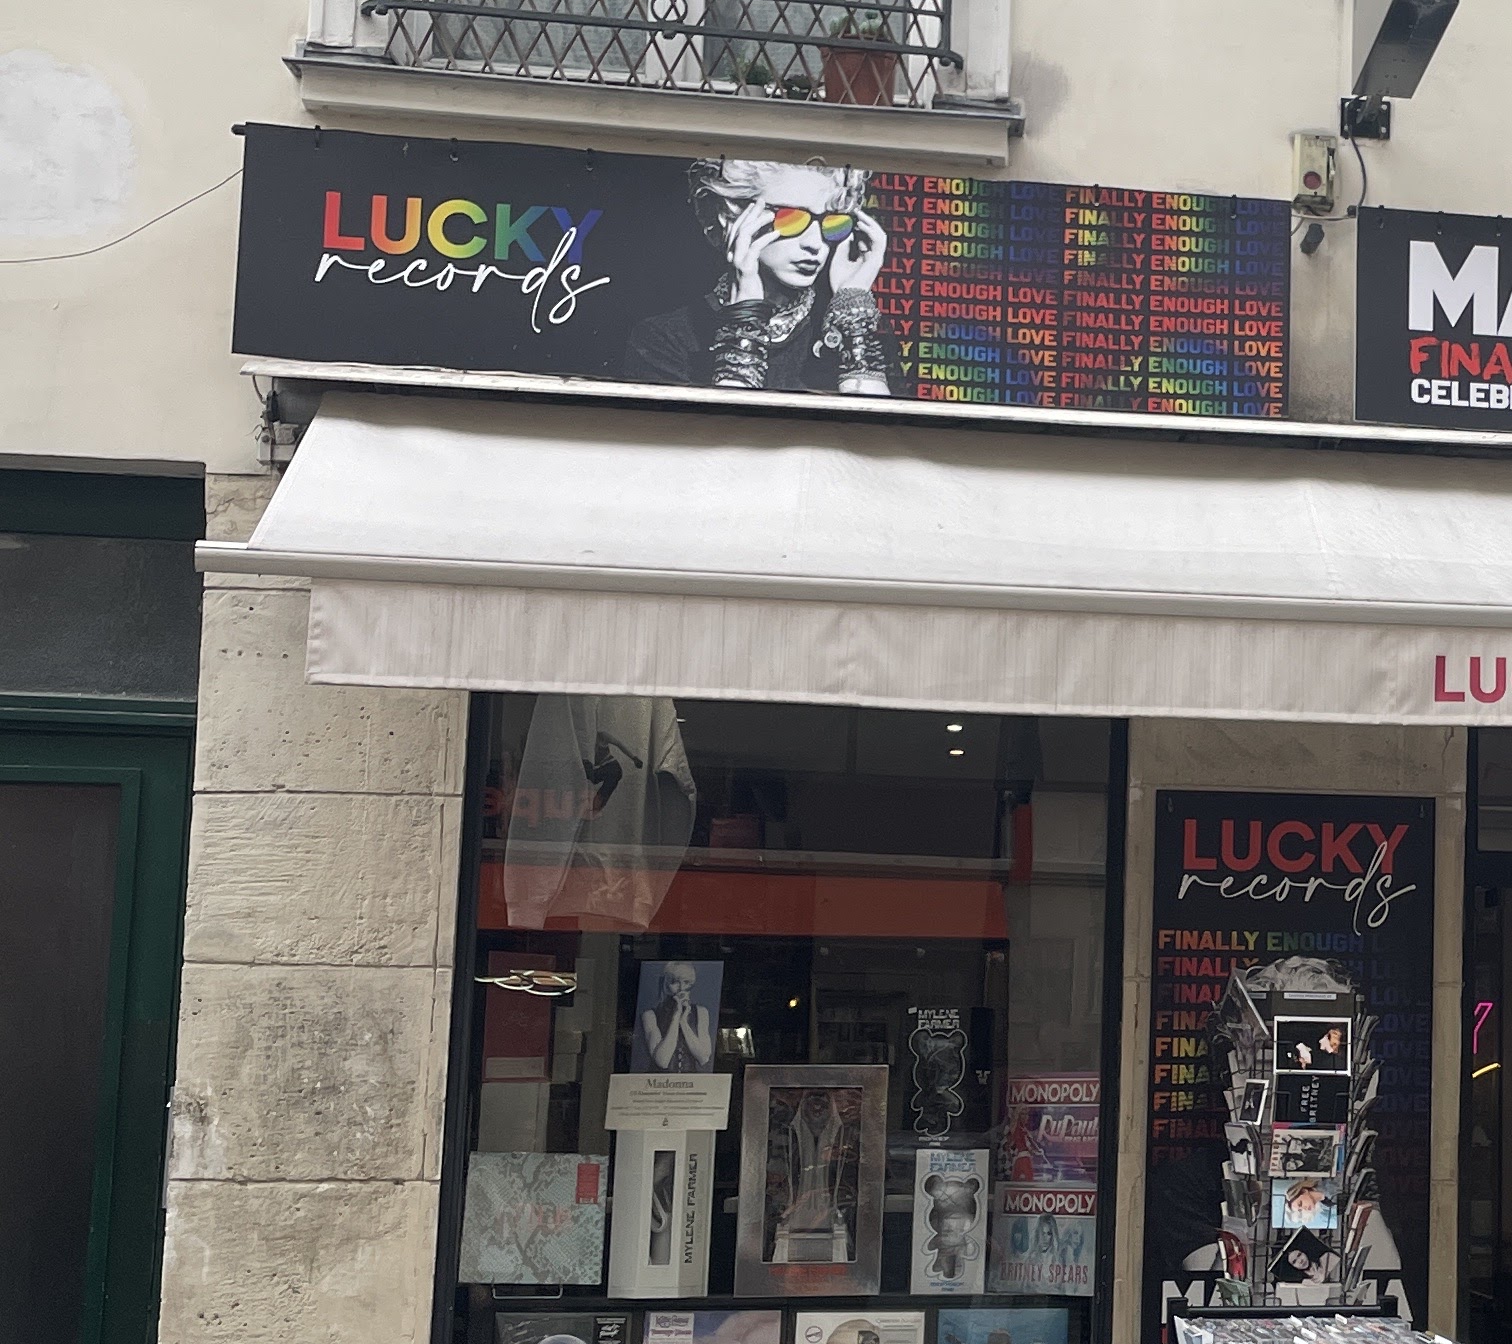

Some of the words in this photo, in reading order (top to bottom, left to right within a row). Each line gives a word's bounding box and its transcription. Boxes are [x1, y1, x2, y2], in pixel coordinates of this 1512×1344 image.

[322, 191, 603, 266] LUCKY
[922, 218, 1004, 240] ENOUGH
[1151, 234, 1230, 254] ENOUGH
[1065, 208, 1146, 228] FINALLY
[921, 239, 1003, 261] ENOUGH
[1151, 254, 1230, 274] ENOUGH
[314, 227, 610, 333] records
[921, 260, 1002, 281] ENOUGH
[1063, 270, 1145, 290] FINALLY
[1150, 274, 1229, 295] ENOUGH
[1235, 280, 1283, 297] LOVE
[920, 280, 1001, 301] ENOUGH
[1008, 286, 1058, 305] LOVE
[1063, 290, 1144, 310] FINALLY
[1150, 294, 1229, 314] ENOUGH
[1234, 299, 1283, 317] LOVE
[920, 300, 1001, 322] ENOUGH
[1008, 308, 1058, 326] LOVE
[1063, 310, 1144, 330] FINALLY
[1149, 315, 1229, 335] ENOUGH
[1233, 320, 1283, 337] LOVE
[919, 321, 1000, 342] ENOUGH
[1007, 327, 1057, 347] LOVE
[1062, 331, 1144, 351] FINALLY
[1149, 336, 1228, 356] ENOUGH
[1233, 340, 1283, 358] LOVE
[919, 342, 1000, 363] ENOUGH
[1006, 348, 1057, 367] LOVE
[1062, 352, 1143, 372] FINALLY
[1148, 356, 1228, 376] ENOUGH
[1233, 360, 1283, 378] LOVE
[918, 362, 1000, 384] ENOUGH
[1006, 369, 1056, 388] LOVE
[1061, 372, 1142, 392] FINALLY
[1148, 376, 1227, 396] ENOUGH
[1233, 381, 1283, 398] LOVE
[917, 383, 999, 404] ENOUGH
[1006, 389, 1056, 407] LOVE
[1148, 397, 1227, 416] ENOUGH
[1232, 402, 1282, 418] LOVE
[1183, 818, 1410, 874] LUCKY
[1177, 841, 1417, 936] records
[1158, 929, 1260, 952] FINALLY
[1266, 931, 1364, 953] ENOUGH
[645, 1078, 694, 1089] Madonna
[1011, 1083, 1100, 1103] MONOPOLY
[687, 1153, 698, 1206] FARMER
[1005, 1192, 1095, 1214] MONOPOLY
[684, 1210, 696, 1264] MYLENE
[1000, 1261, 1043, 1282] BRITNEY
[1048, 1263, 1089, 1285] SPEARS
